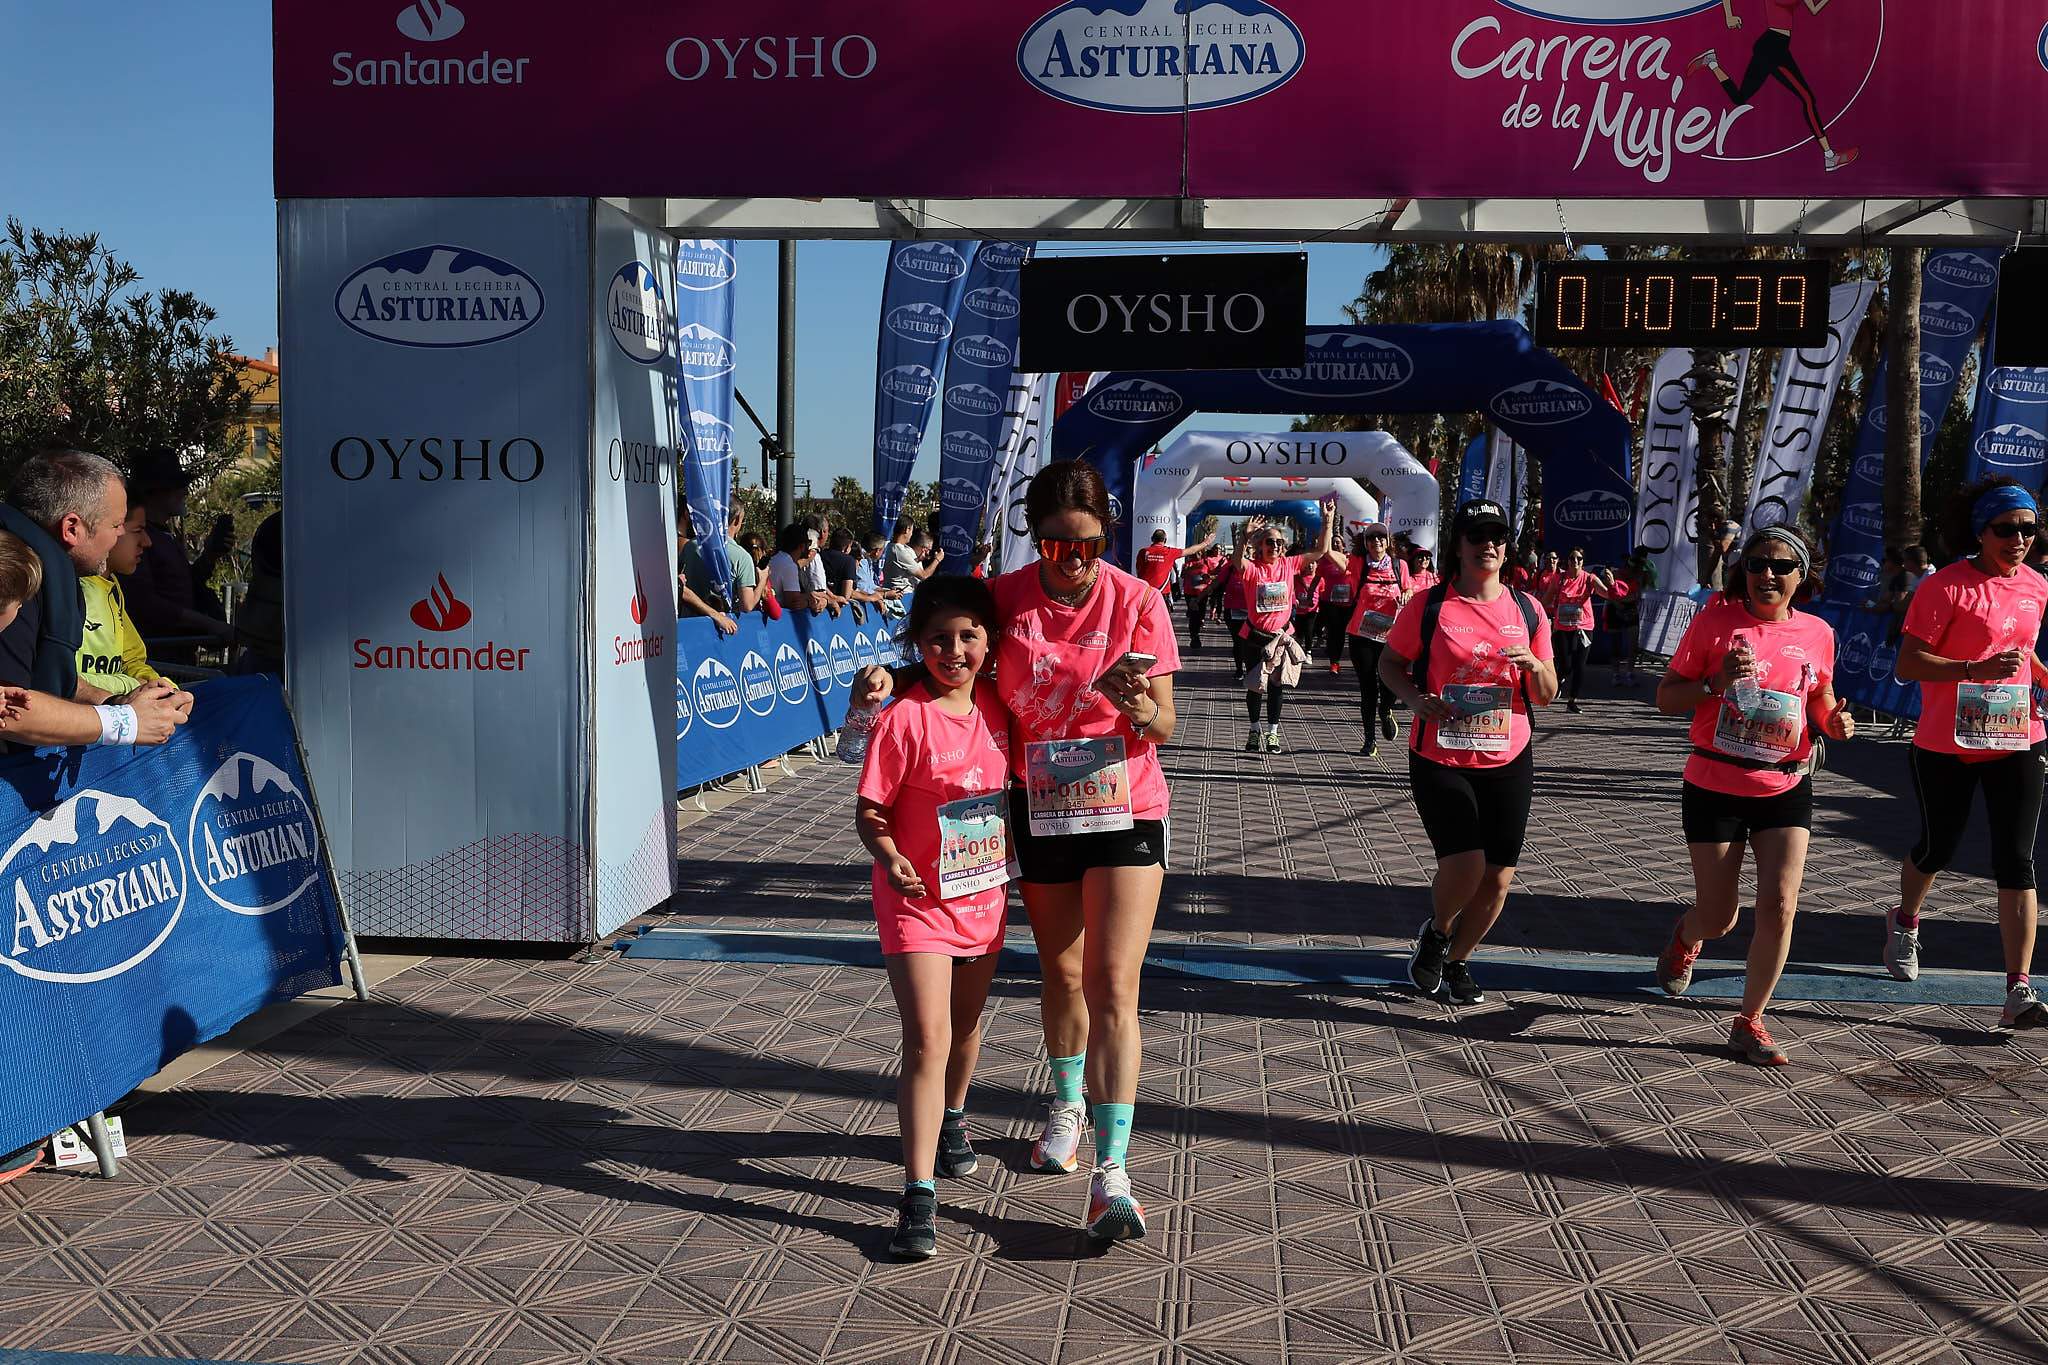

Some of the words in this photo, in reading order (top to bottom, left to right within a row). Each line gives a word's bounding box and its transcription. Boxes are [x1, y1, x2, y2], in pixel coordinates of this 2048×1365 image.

[1083, 25, 1172, 38] CENTRAL
[665, 34, 878, 81] OYSHO
[1039, 29, 1282, 78] ASTURIANA
[1450, 15, 1672, 81] Carrera
[332, 50, 530, 86] Santander
[1501, 83, 1543, 128] de
[1551, 82, 1581, 128] la
[1572, 75, 1754, 183] Mujer
[1931, 260, 1992, 283] ASTURIANA
[383, 281, 448, 292] CENTRAL
[455, 281, 521, 291] LECHERA
[350, 284, 529, 322] ASTURIANA
[1066, 293, 1265, 333] OYSHO
[611, 290, 666, 343] ASTURIANA
[1920, 314, 1969, 332] STURIANA
[1919, 367, 1947, 382] RIANA
[1991, 374, 2048, 394] ASTURIA
[950, 390, 998, 412] ASTURIANA
[1093, 396, 1175, 412] ASTURIANA
[1500, 398, 1586, 415] ASTURIANA
[1752, 327, 1842, 530] OYSHO
[330, 436, 544, 483] OYSHO
[609, 438, 670, 486] OYSHO
[1226, 440, 1347, 465] OYSHO
[1154, 467, 1190, 477] OYSHO
[1381, 467, 1418, 477] OYSHO
[1641, 379, 1689, 555] OYSHO
[1137, 515, 1171, 525] OYSHO
[1398, 518, 1433, 527] OYSHO
[1559, 506, 1628, 522] ASTURIANA
[1442, 624, 1474, 634] OYSHO
[353, 638, 531, 671] Santander
[614, 633, 664, 666] Santander
[698, 687, 740, 714] ASTURIANA
[1463, 714, 1491, 726] 016
[926, 750, 965, 765] OYSHO
[1054, 754, 1095, 763] ASTURIANA
[1058, 780, 1097, 798] 016
[1033, 811, 1056, 819] CARRERA
[1074, 808, 1094, 816] MUJER
[1067, 800, 1086, 809] 3457
[216, 803, 260, 829] CENTRAL
[1039, 821, 1070, 831] OYSHO
[1090, 819, 1121, 828] Santander
[203, 821, 312, 886] ASTURIAN
[968, 835, 999, 856] 016
[41, 852, 102, 883] CENTRAL
[977, 856, 992, 866] 3459
[945, 871, 968, 881] CARRERA
[951, 879, 980, 891] OYSHO
[11, 856, 180, 957] ASTURIANA
